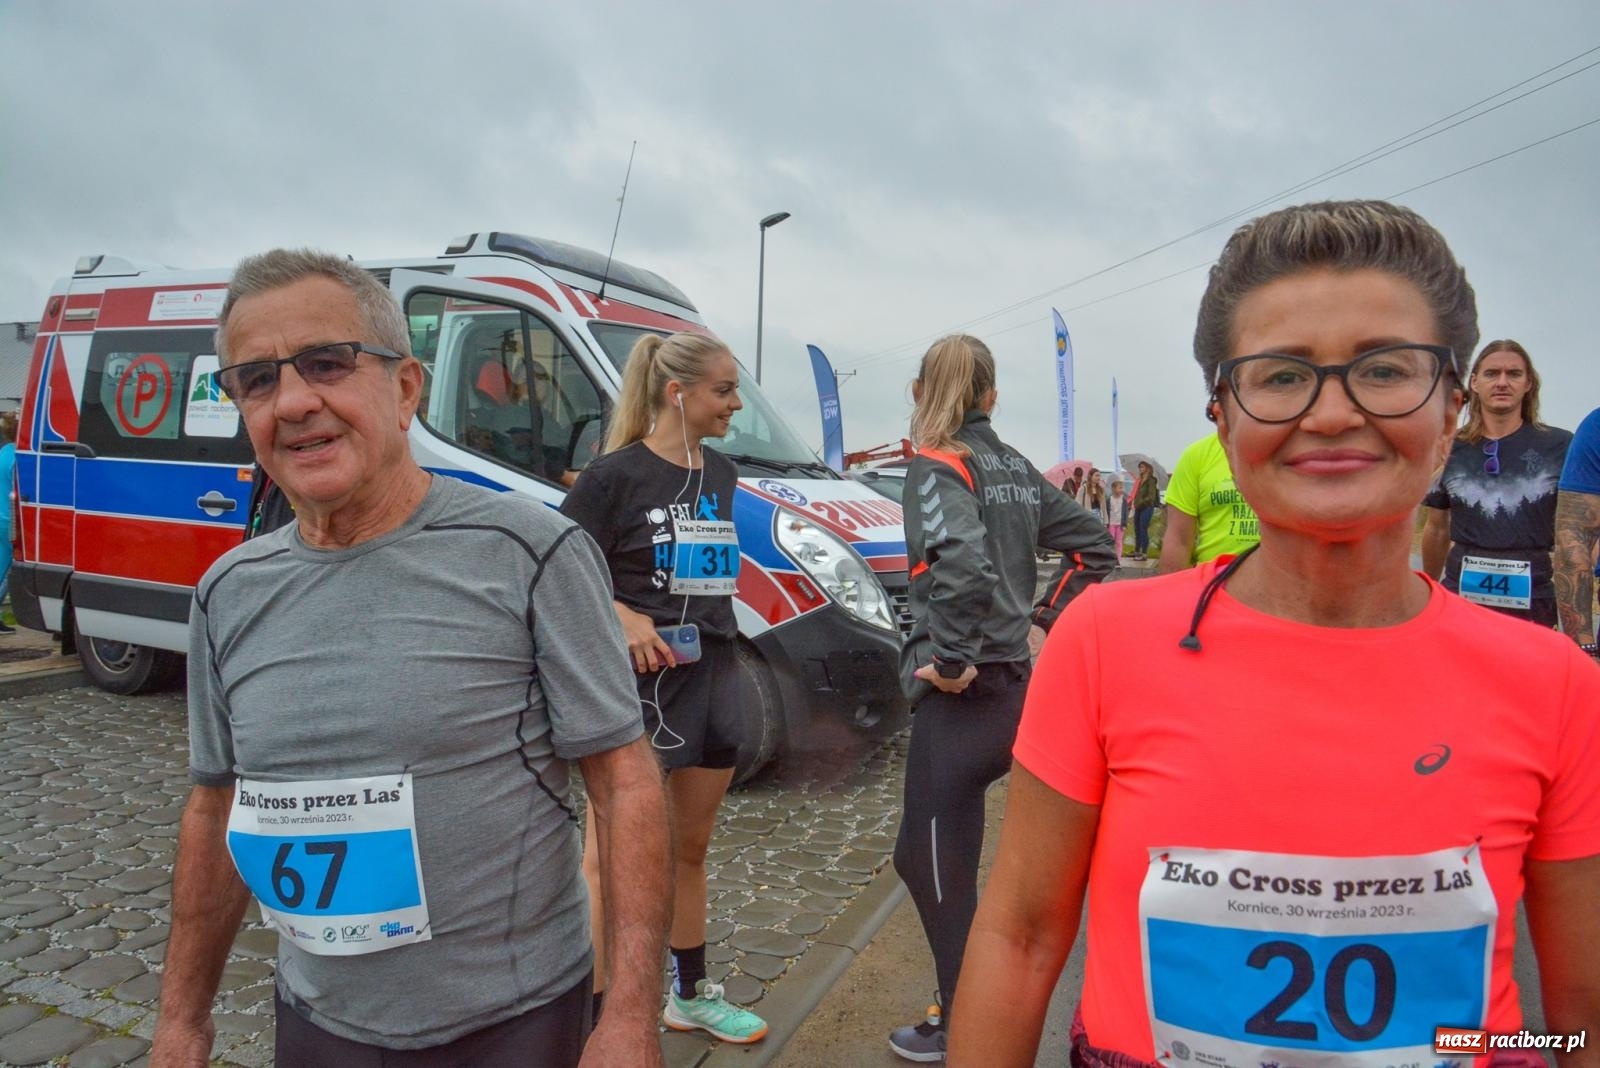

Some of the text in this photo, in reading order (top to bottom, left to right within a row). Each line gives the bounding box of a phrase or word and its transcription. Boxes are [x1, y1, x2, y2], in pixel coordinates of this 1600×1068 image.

[133, 372, 158, 418] P
[696, 525, 717, 533] Cross
[702, 545, 732, 576] 31
[1479, 574, 1510, 595] 44
[239, 788, 400, 811] Eko Cross przez Las
[280, 816, 289, 824] 30
[290, 815, 324, 824] września
[326, 814, 347, 823] 2023
[271, 840, 348, 910] 67
[1161, 861, 1473, 902] Eko Cross przez Las
[1228, 899, 1416, 919] Kornice, 30 września 2023 r.
[1244, 940, 1397, 1042] 20
